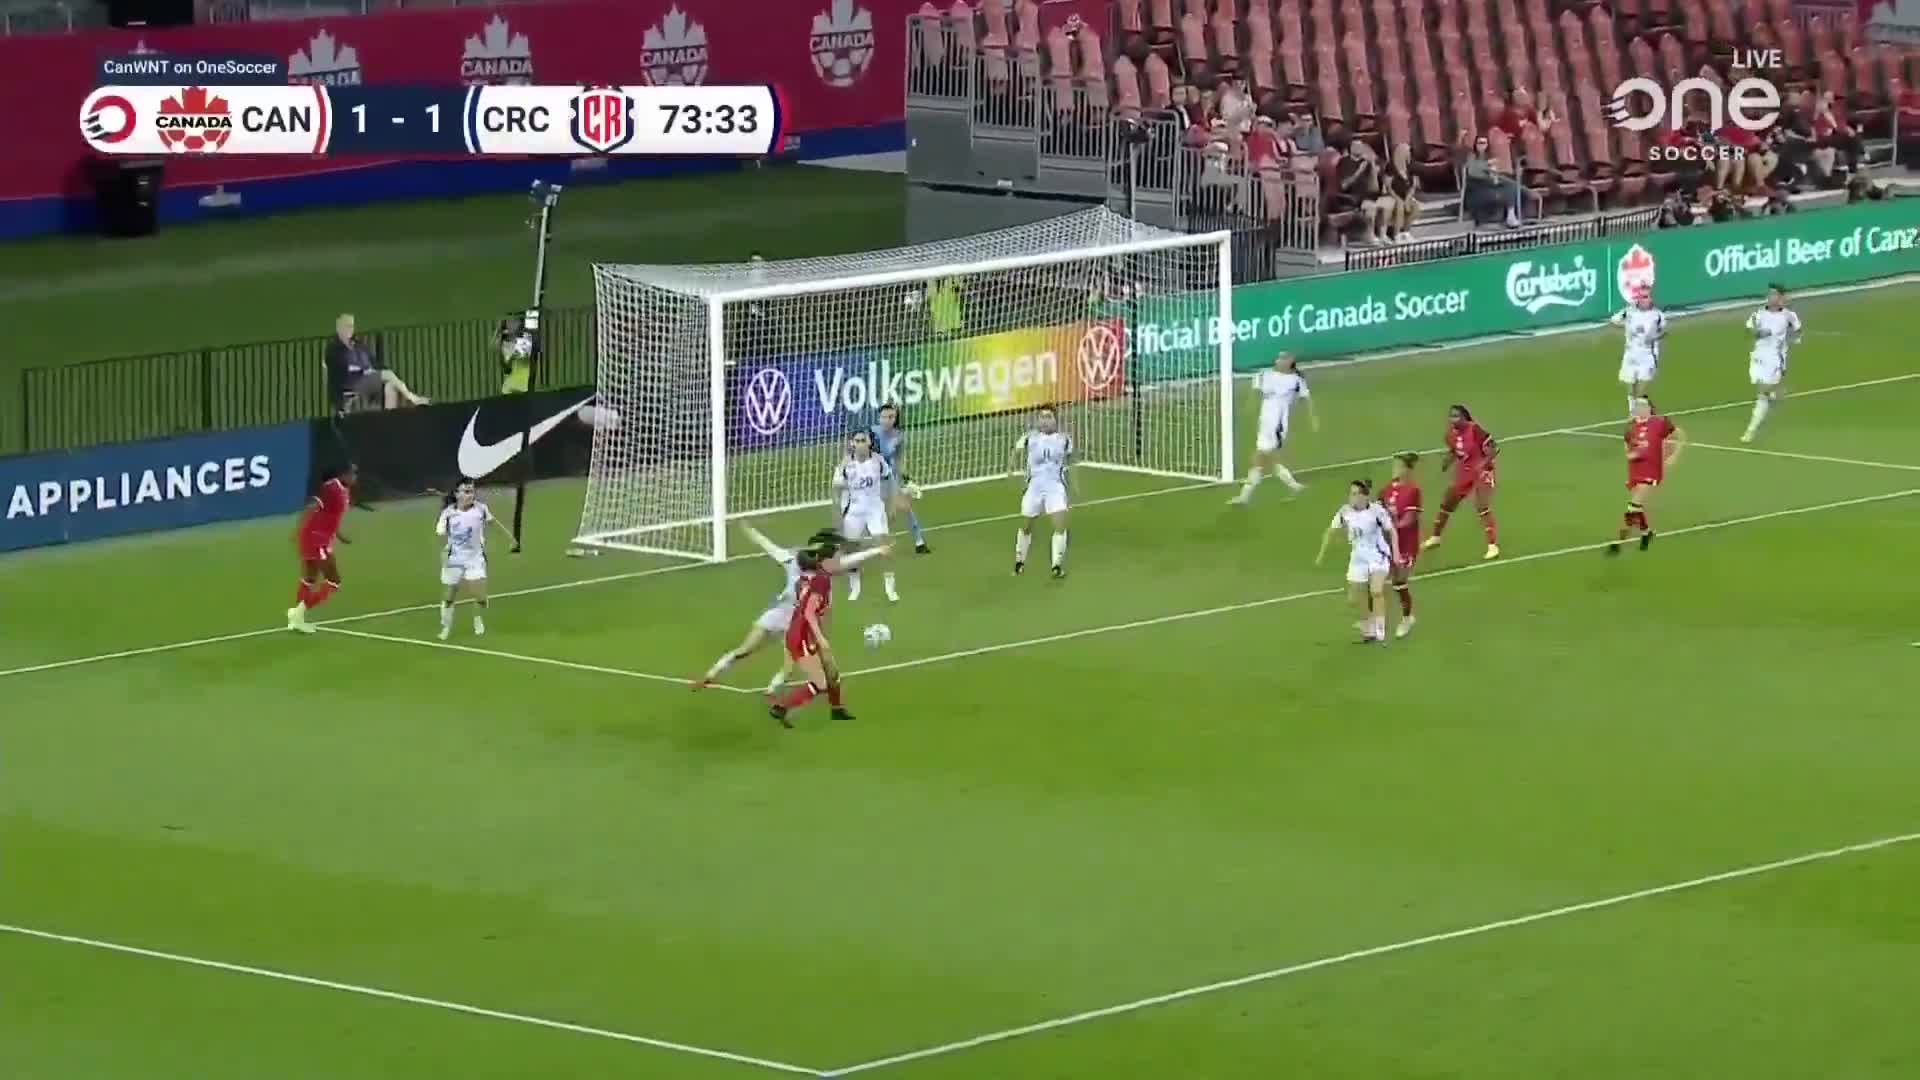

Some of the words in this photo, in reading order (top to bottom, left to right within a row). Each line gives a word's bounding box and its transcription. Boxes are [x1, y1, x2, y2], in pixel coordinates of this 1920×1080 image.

[639, 46, 708, 66] CANADA
[808, 31, 875, 52] CANADA
[460, 59, 533, 76] CANADA
[1705, 239, 1780, 277] Official
[1786, 238, 1834, 266] Beer
[1839, 227, 1862, 257] of
[1866, 226, 1920, 254] Cana
[1506, 255, 1597, 307] Carlsberg
[1268, 305, 1293, 337] of
[1299, 296, 1387, 333] Canada
[1395, 289, 1470, 320] Soccer
[814, 351, 1058, 414] Volkswagen
[6, 455, 271, 519] APPLIANCES
